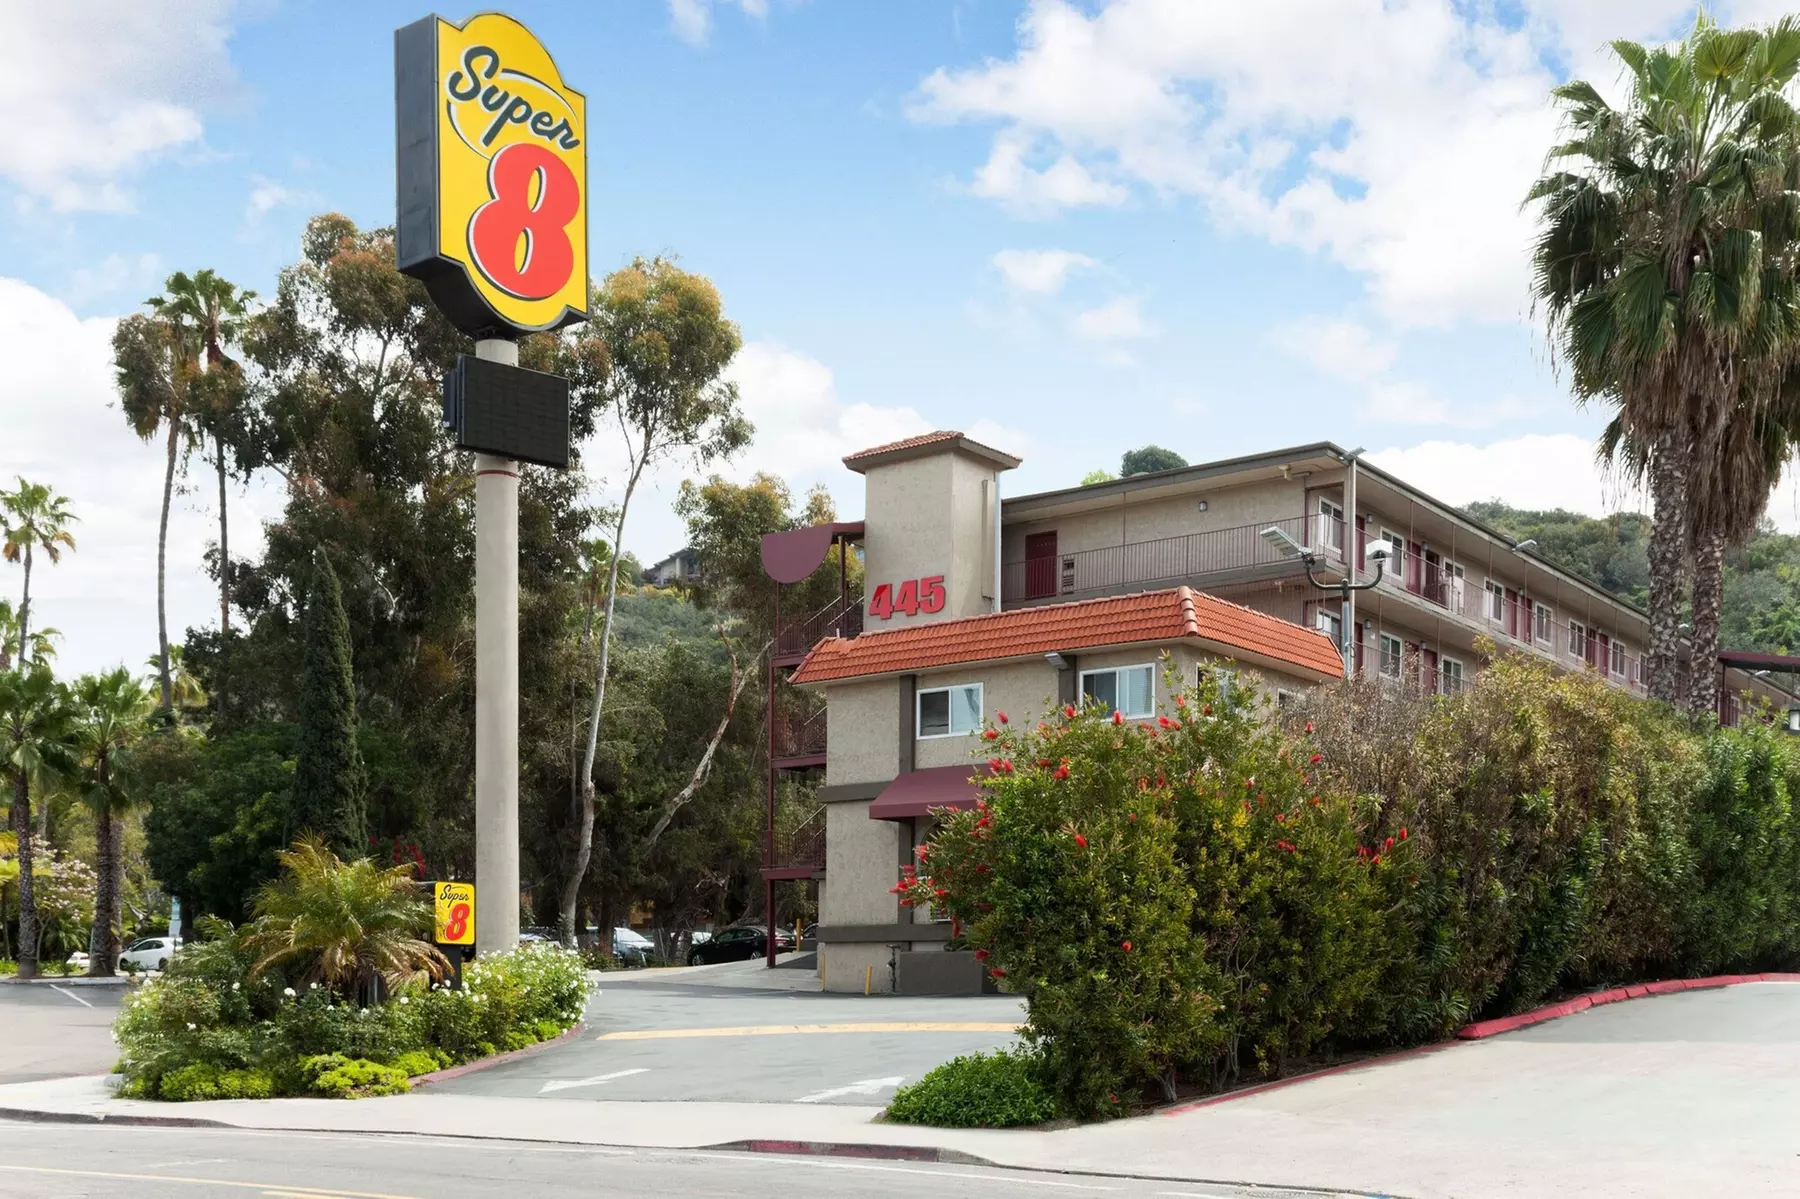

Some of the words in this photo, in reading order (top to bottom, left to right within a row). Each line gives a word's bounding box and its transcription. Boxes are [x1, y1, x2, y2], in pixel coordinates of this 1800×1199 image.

[448, 45, 580, 150] Super
[466, 142, 580, 302] 8
[869, 575, 946, 620] 445
[440, 884, 470, 908] Super
[446, 903, 470, 940] 8
